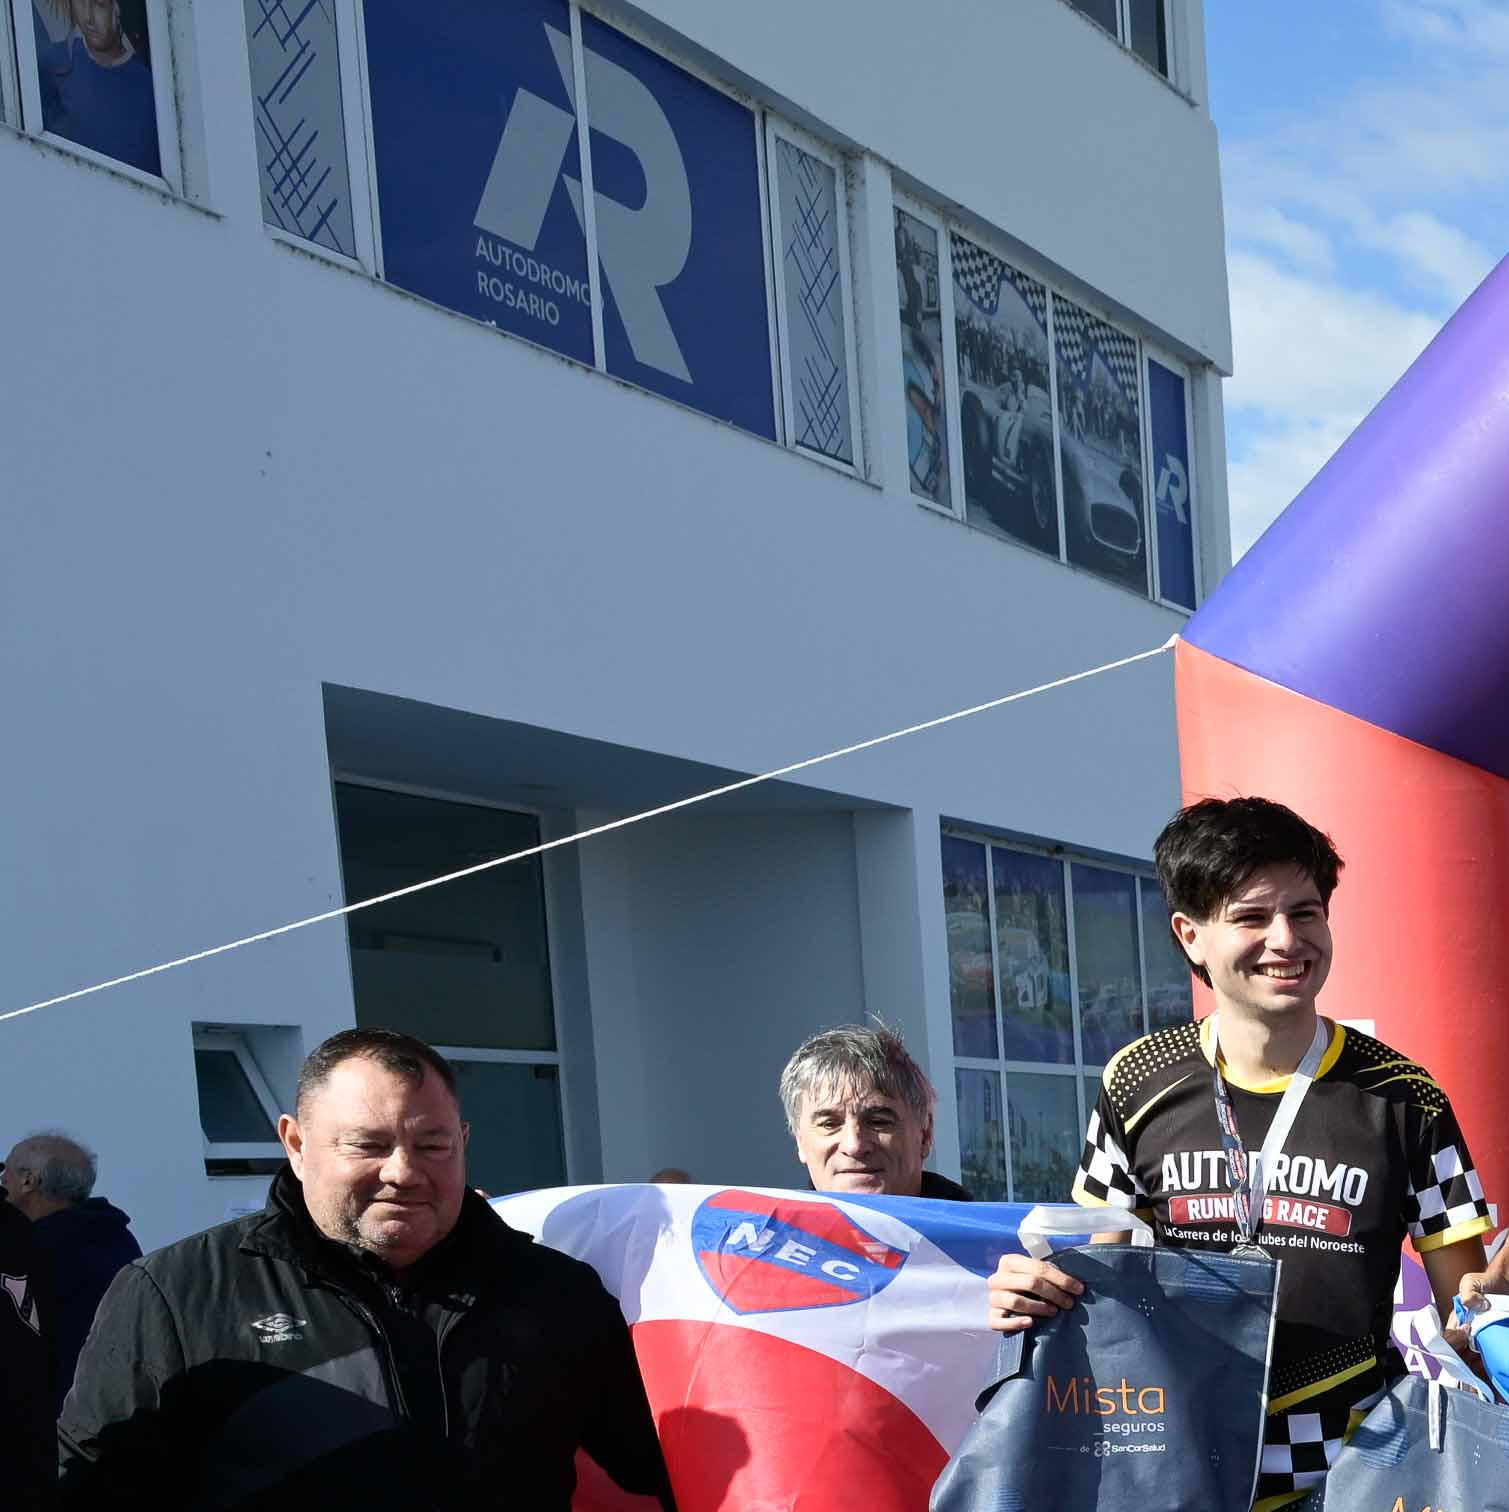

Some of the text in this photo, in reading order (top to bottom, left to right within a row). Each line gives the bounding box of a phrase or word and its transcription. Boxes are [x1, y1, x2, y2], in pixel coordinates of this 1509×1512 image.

[478, 271, 560, 325] ROSARIO
[1161, 1149, 1369, 1207] AUTROMO
[1277, 1198, 1329, 1230] RACE
[725, 1221, 861, 1281] NEC
[1173, 1228, 1209, 1242] Carrera
[1212, 1229, 1228, 1242] de
[1258, 1231, 1286, 1247] lubes
[1288, 1234, 1308, 1249] del
[1311, 1235, 1365, 1254] Noroeste
[1046, 1375, 1166, 1416] Mista
